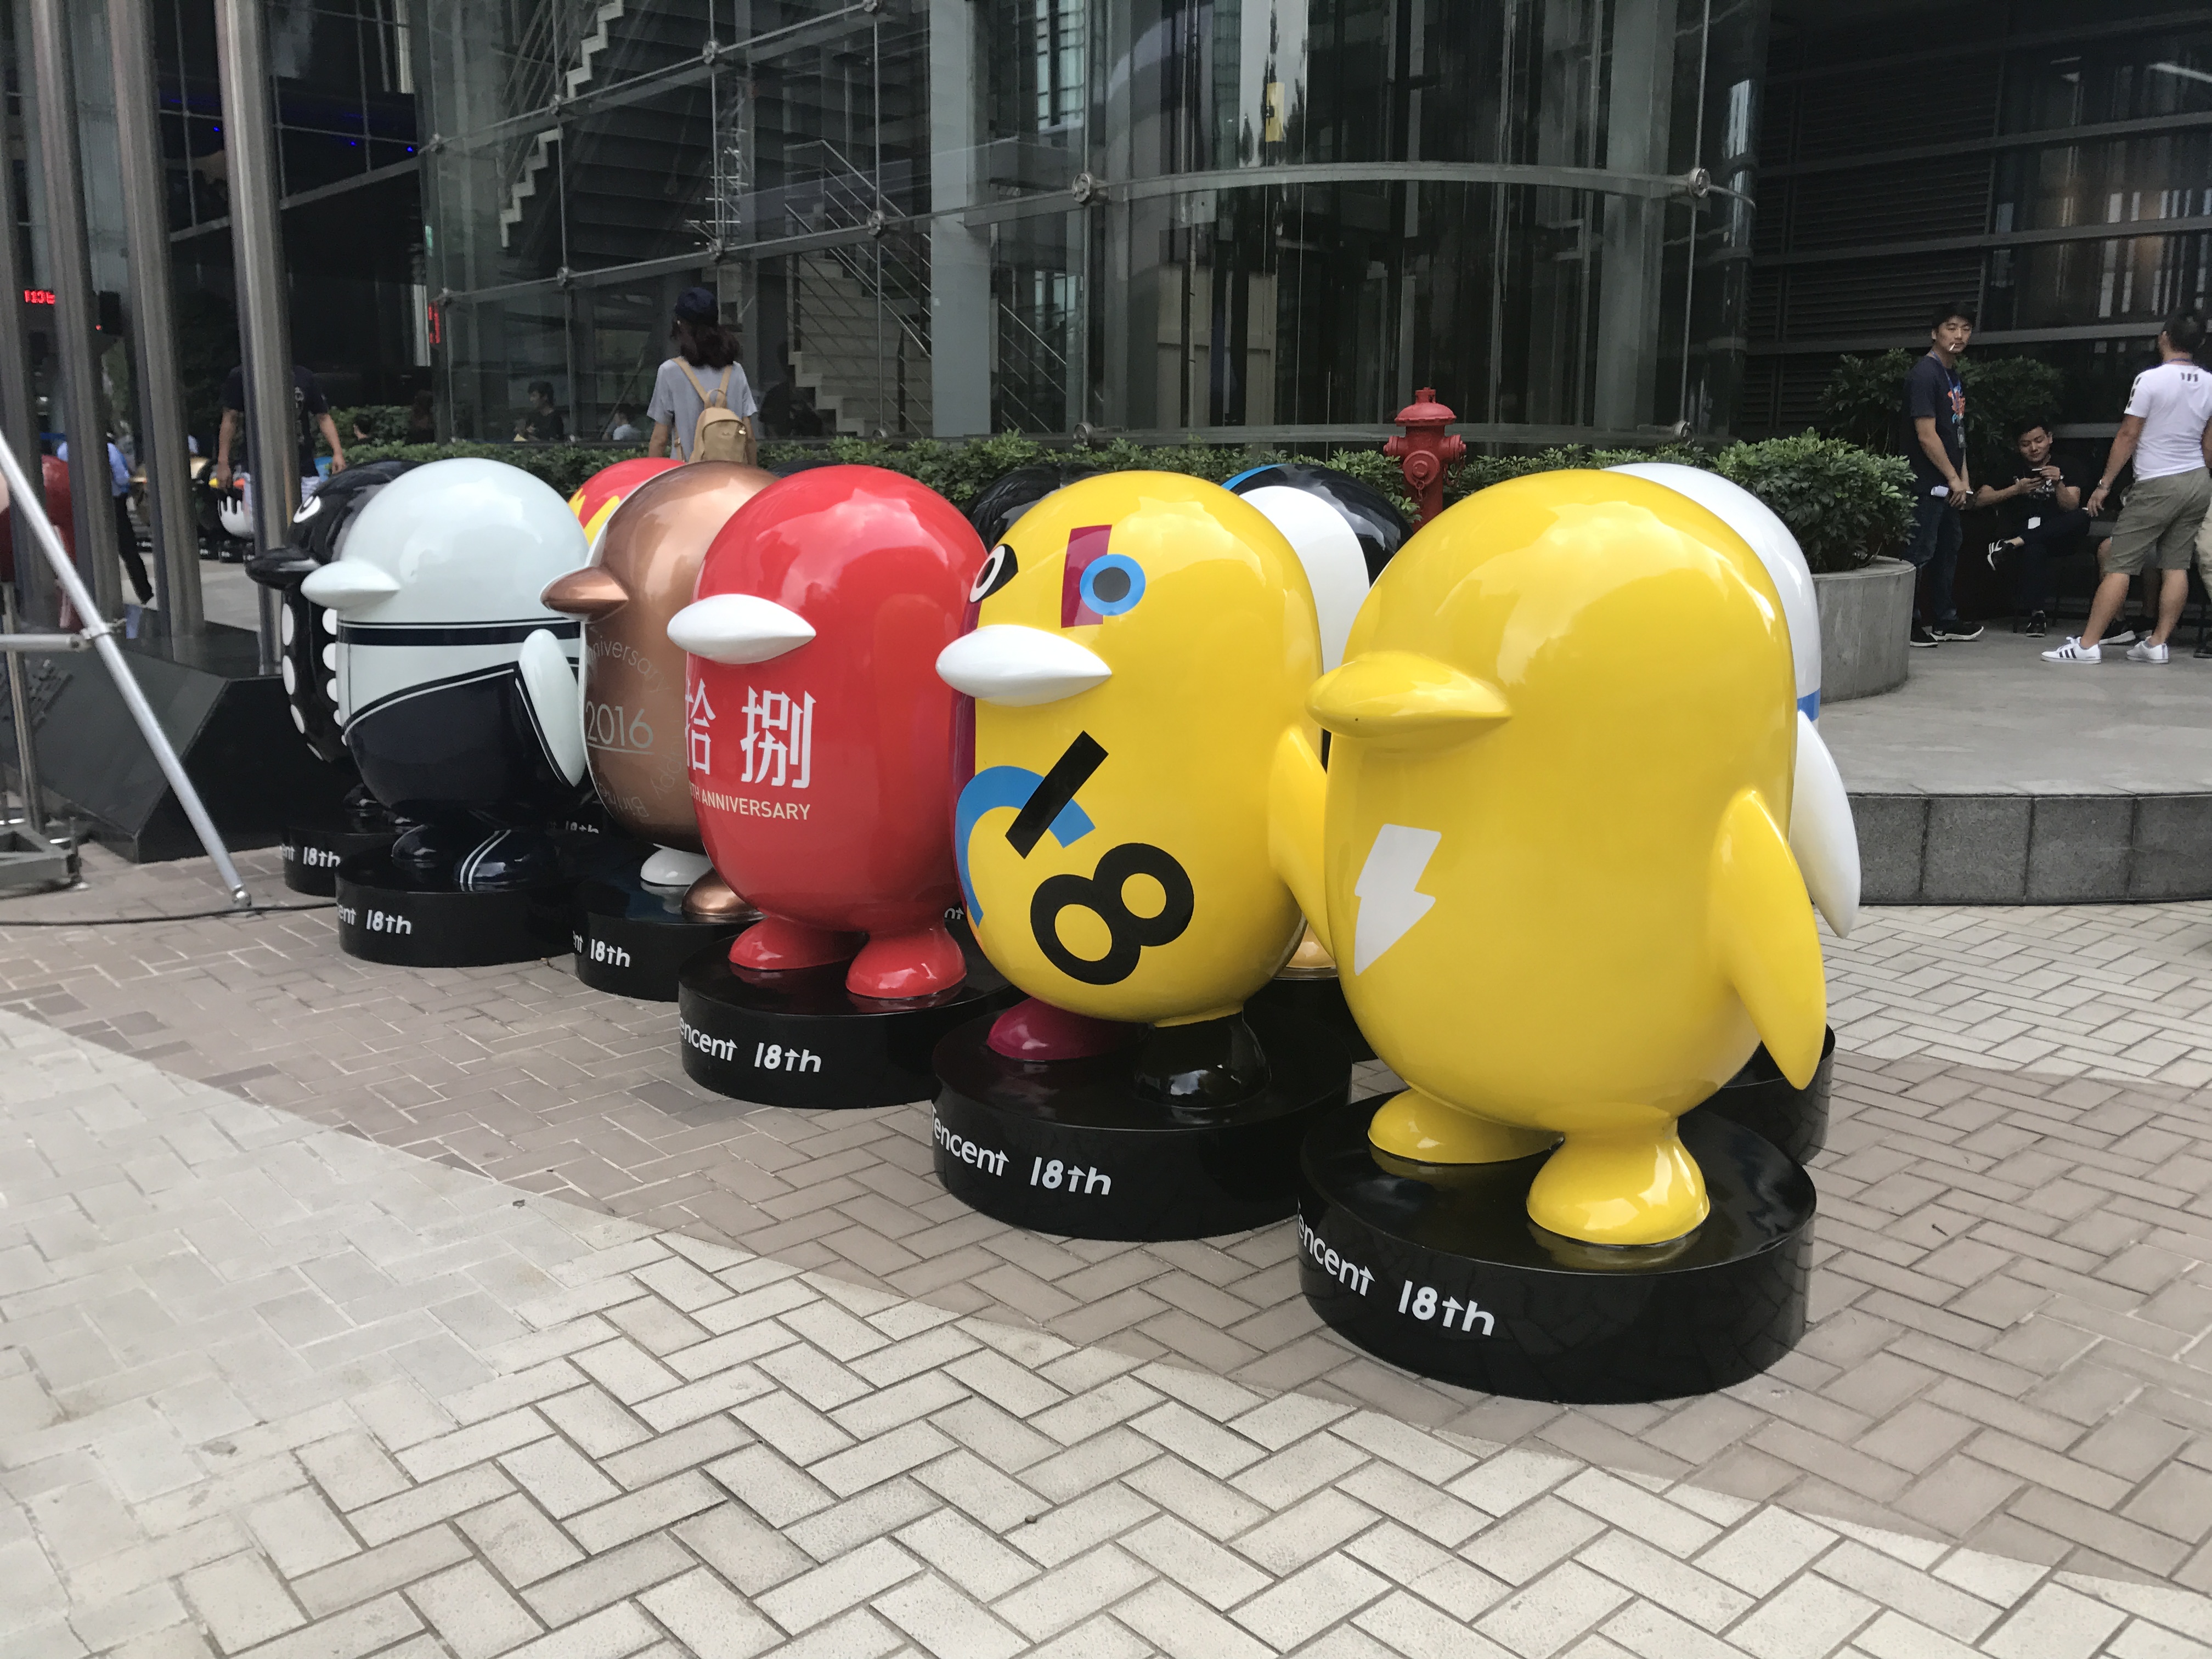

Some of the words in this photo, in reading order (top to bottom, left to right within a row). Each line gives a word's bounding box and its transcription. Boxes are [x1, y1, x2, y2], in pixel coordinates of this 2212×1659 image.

[587, 635, 670, 693] nniversary
[586, 701, 653, 748] 2016
[702, 789, 811, 820] ANNIVERSARY
[303, 847, 341, 867] 18th
[366, 909, 411, 935] 18th
[590, 939, 630, 968] 18th
[680, 1017, 738, 1062] encent
[754, 1042, 822, 1073] 18th
[1030, 1156, 1111, 1195] 18th
[1298, 1210, 1376, 1297] encent
[1398, 1279, 1495, 1336] 18th
